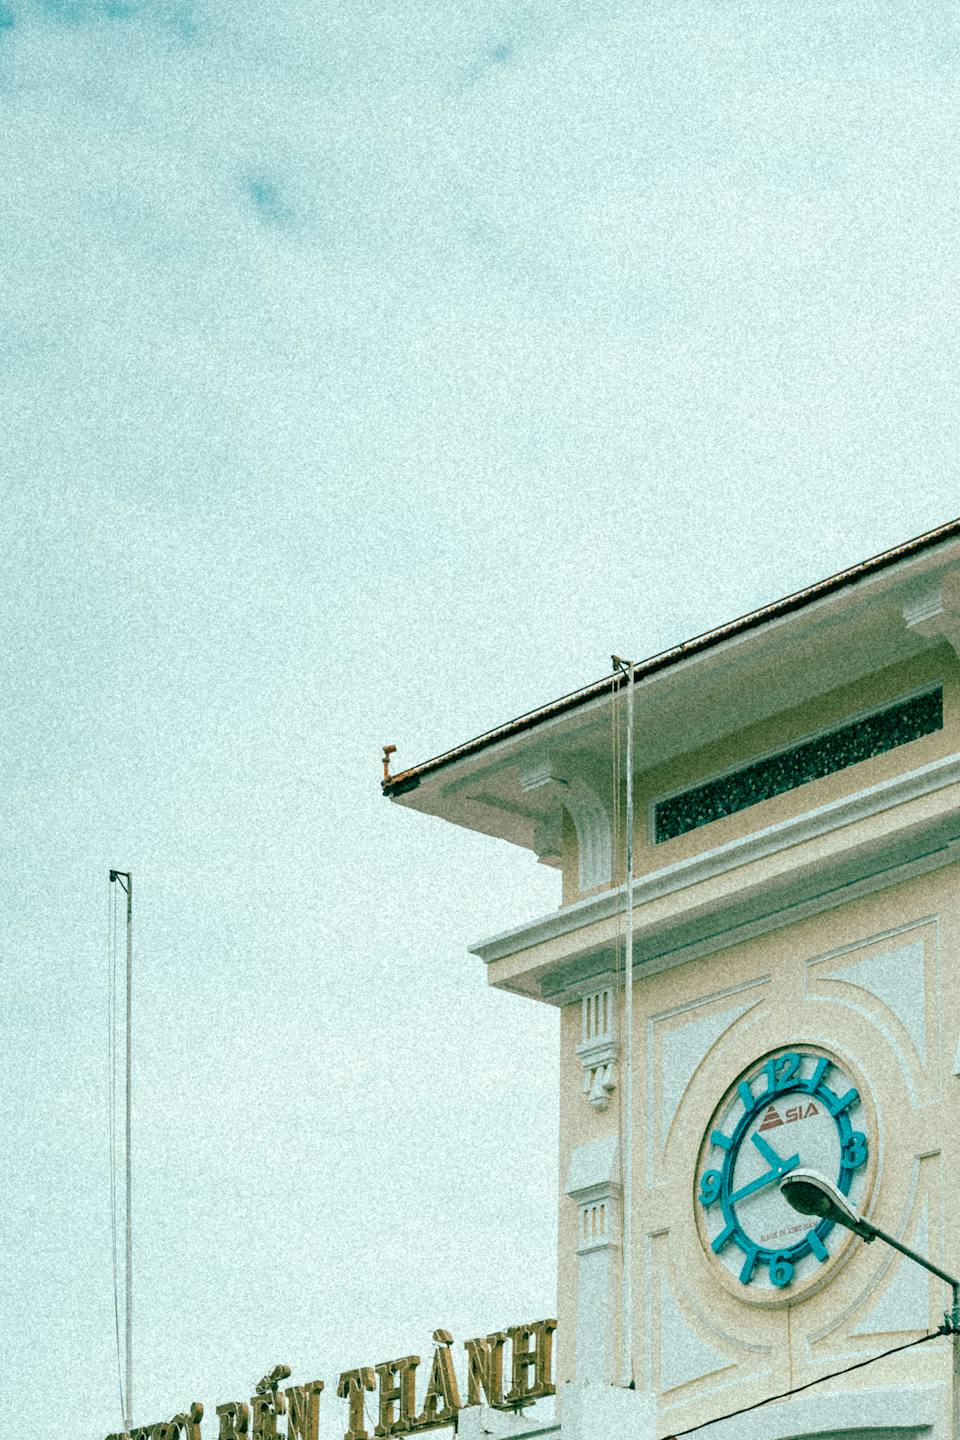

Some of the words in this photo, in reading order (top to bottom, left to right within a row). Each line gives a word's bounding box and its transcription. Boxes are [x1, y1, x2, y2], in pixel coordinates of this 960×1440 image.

[763, 1052, 801, 1095] 12
[841, 1131, 868, 1169] 3
[699, 1170, 723, 1207] 9
[769, 1252, 795, 1288] 6
